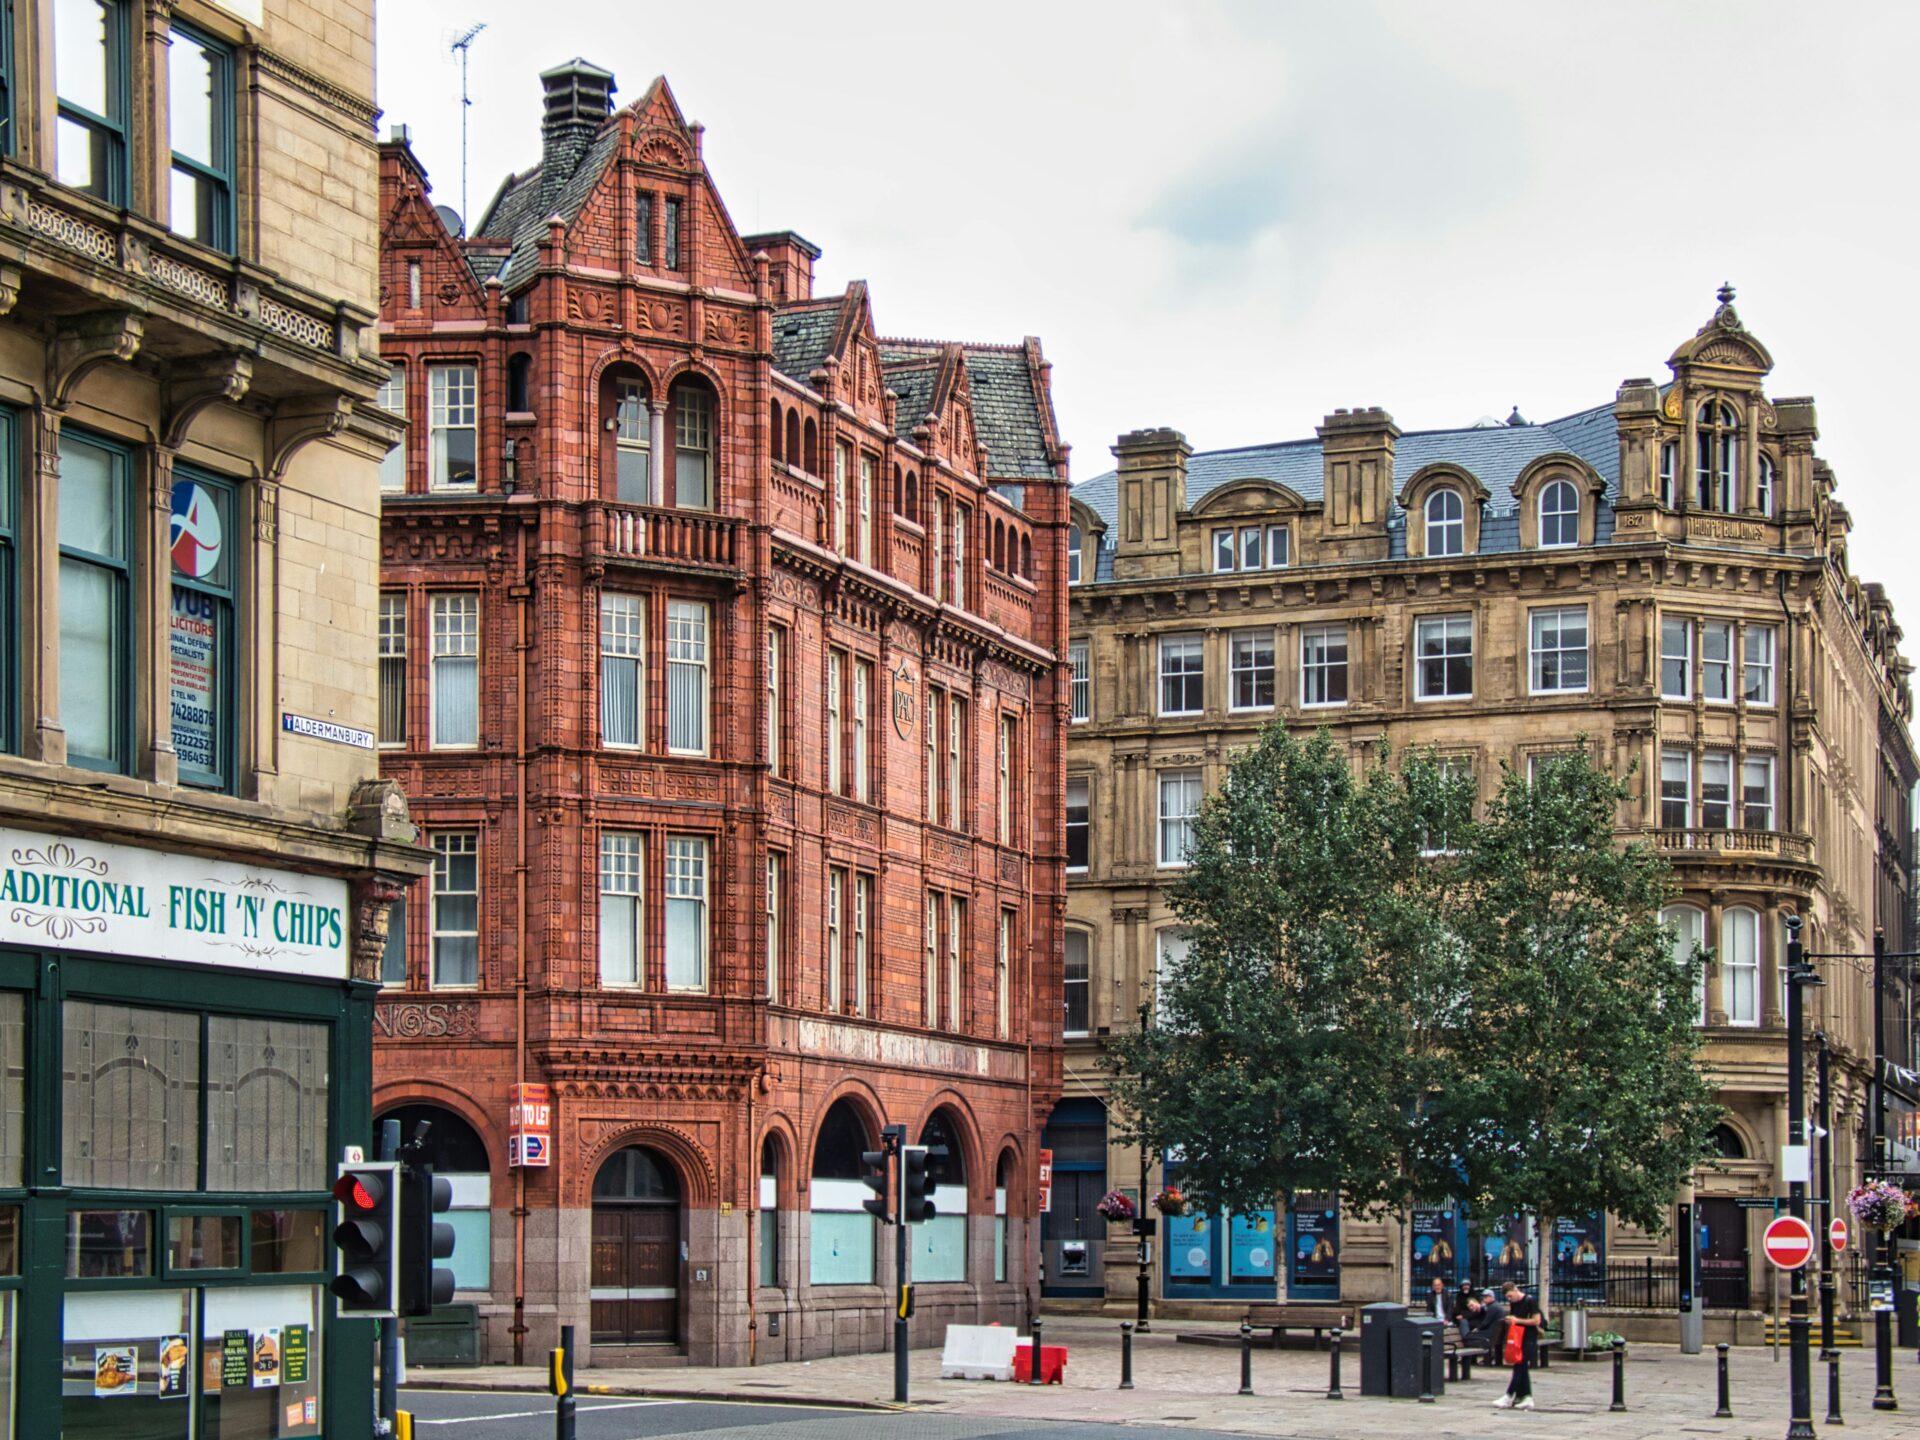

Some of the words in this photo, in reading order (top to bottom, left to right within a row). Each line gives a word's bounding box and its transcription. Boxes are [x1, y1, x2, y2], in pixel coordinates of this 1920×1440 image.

[1687, 516, 1720, 538] THORPE
[1724, 520, 1765, 541] BUILDINGS
[176, 690, 186, 700] TEL
[294, 717, 369, 747] ALDERMANBURY
[174, 747, 215, 767] 5964532
[168, 884, 227, 935] FISH
[236, 894, 265, 938] 'N'
[273, 899, 342, 949] CHIPS
[522, 1104, 535, 1126] TO
[536, 1105, 550, 1126] LET
